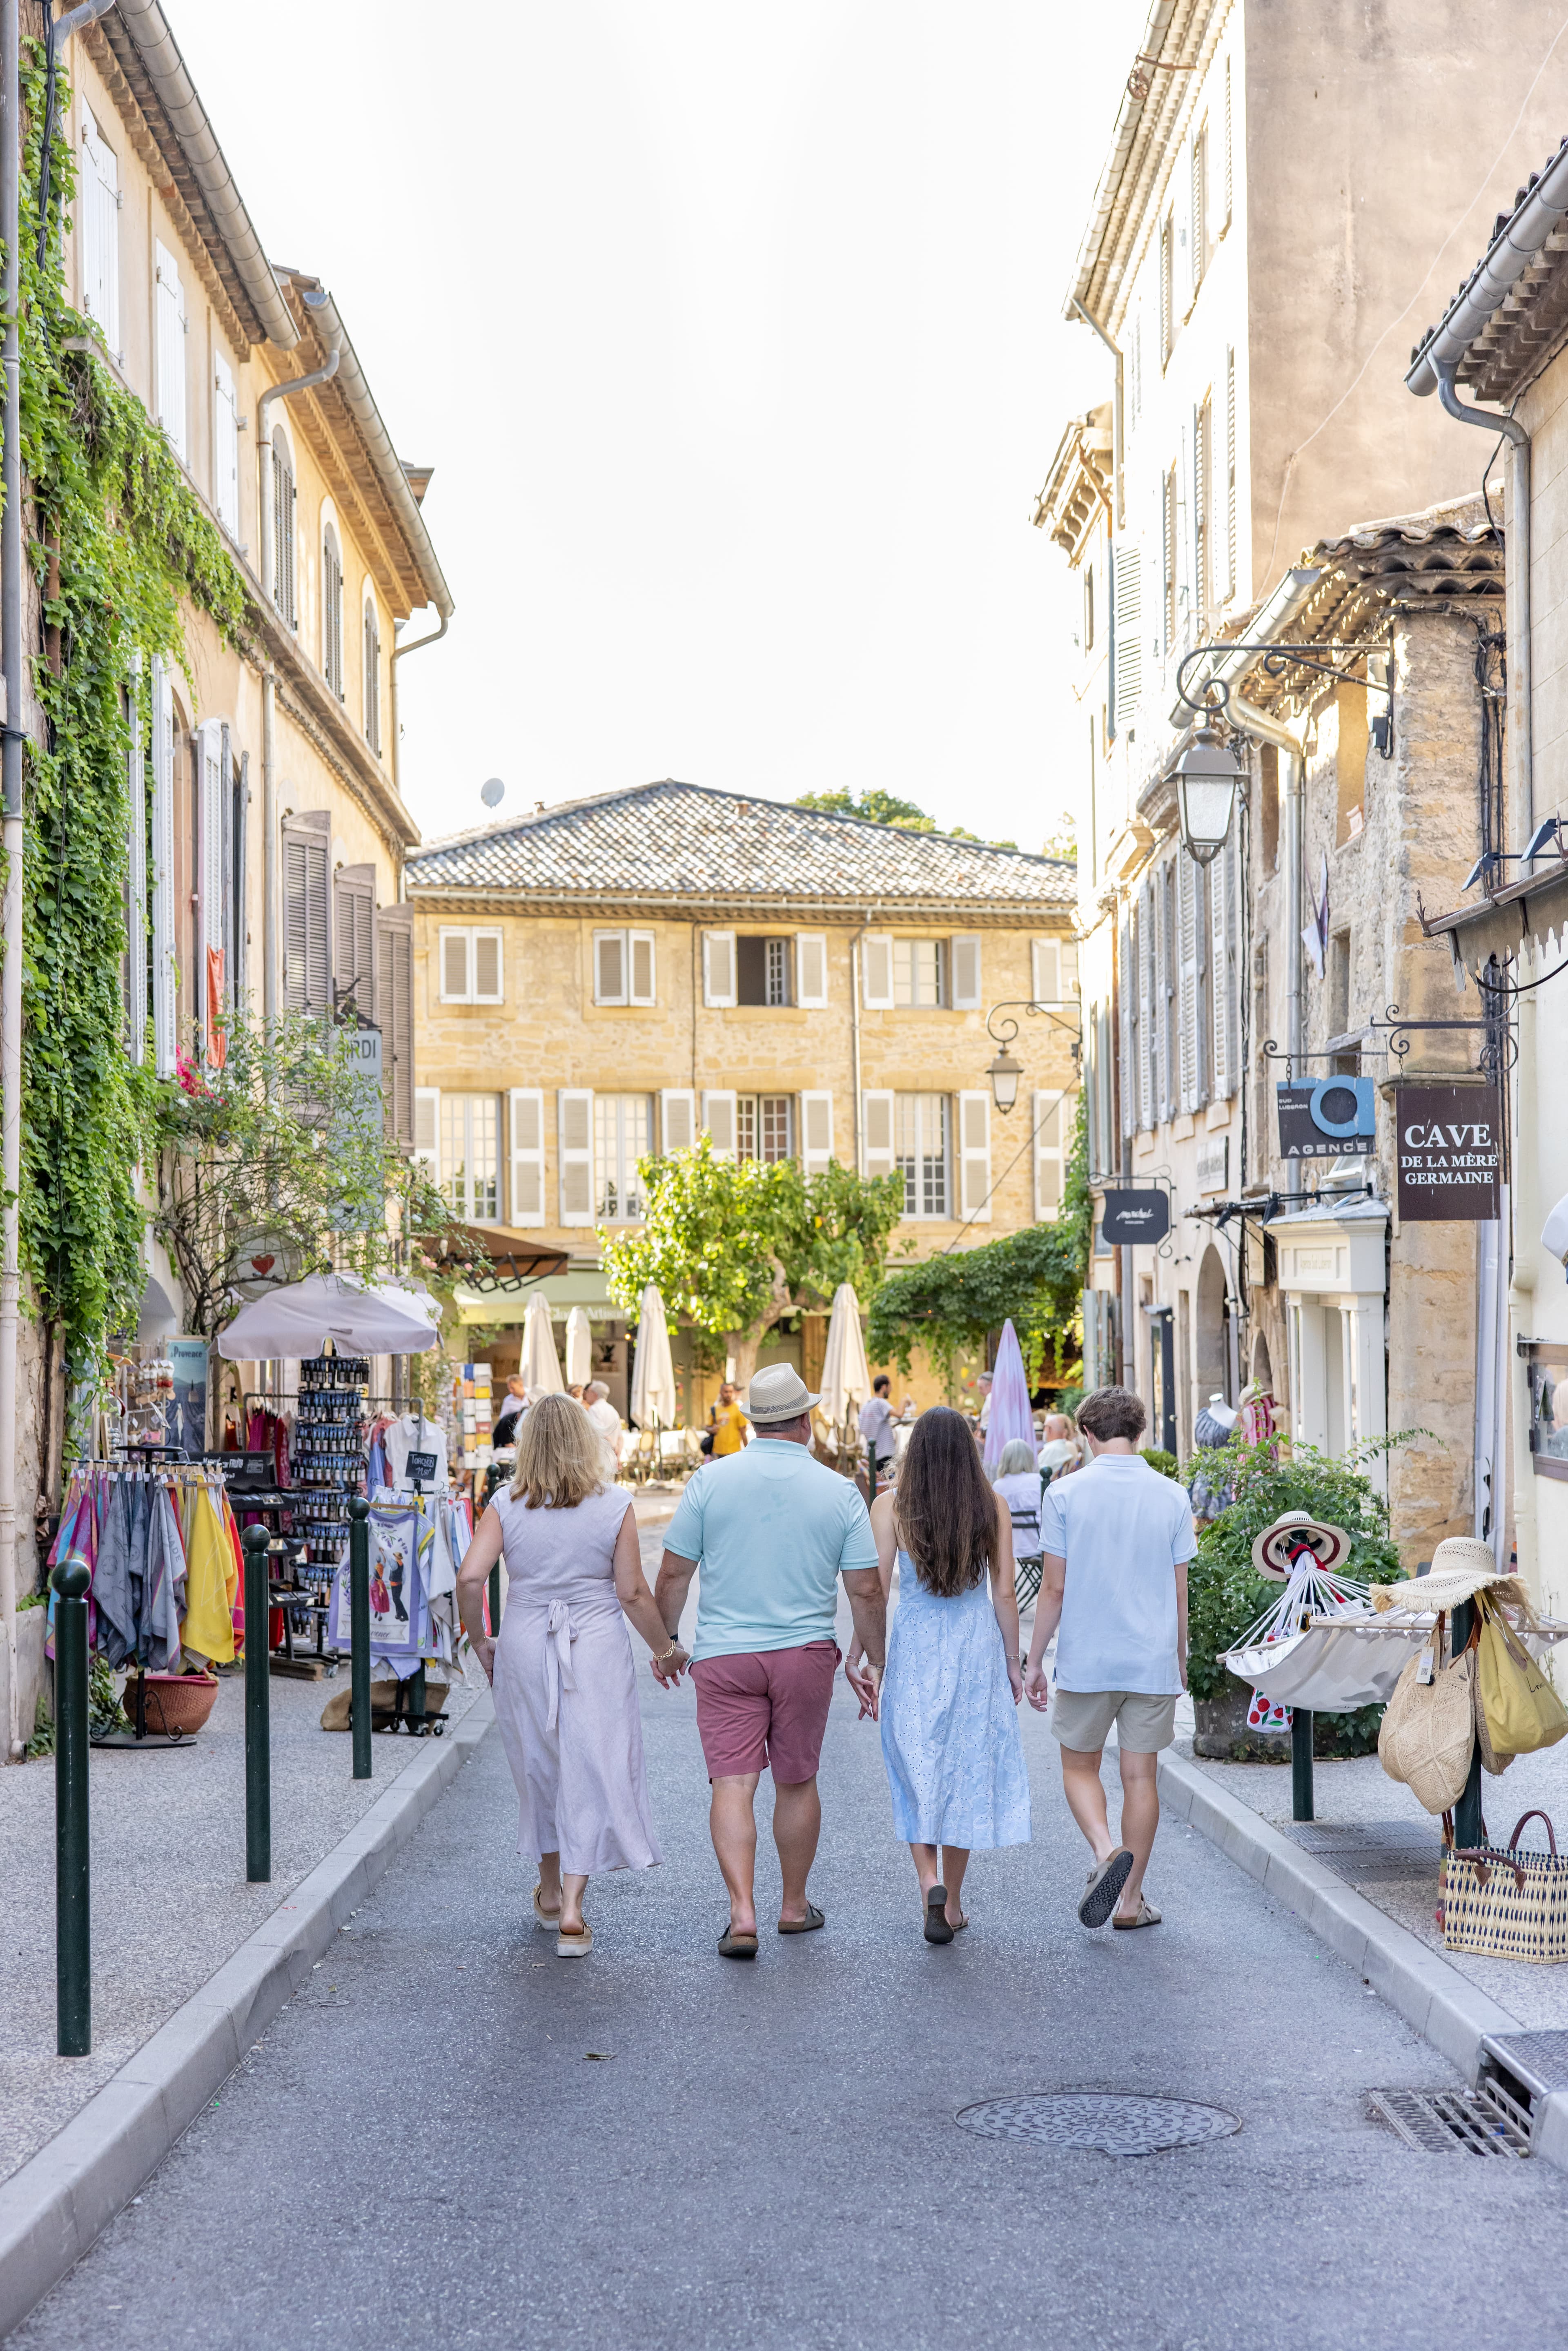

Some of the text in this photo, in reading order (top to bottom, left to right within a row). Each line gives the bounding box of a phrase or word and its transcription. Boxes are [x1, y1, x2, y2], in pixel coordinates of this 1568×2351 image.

[1404, 1124, 1491, 1148] CAVE
[1288, 1142, 1367, 1155] AGENCE
[1401, 1152, 1498, 1168] DE LA MÈRE
[1405, 1171, 1494, 1185] GERMAINE
[174, 1346, 203, 1357] Provence
